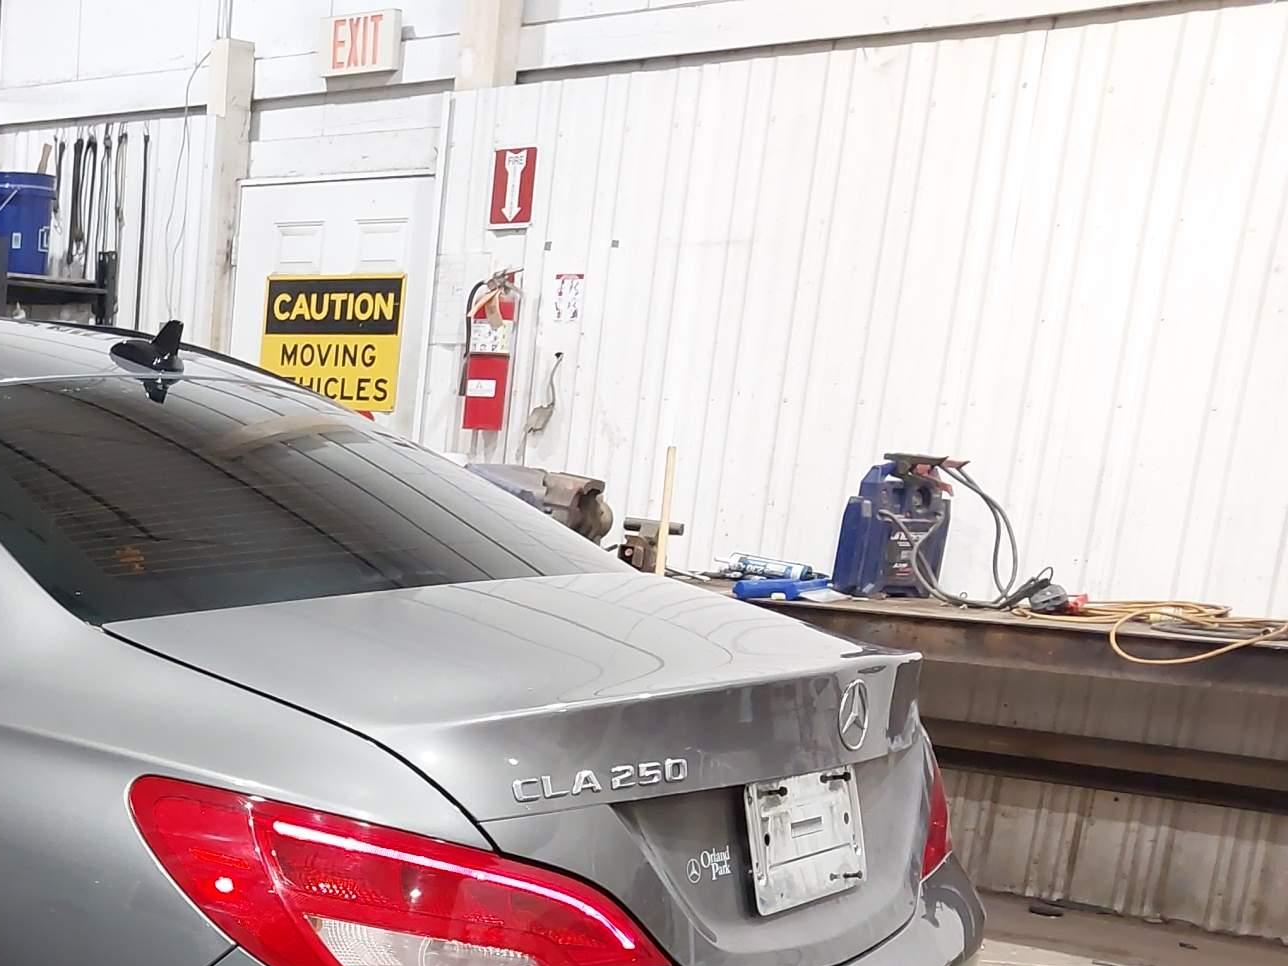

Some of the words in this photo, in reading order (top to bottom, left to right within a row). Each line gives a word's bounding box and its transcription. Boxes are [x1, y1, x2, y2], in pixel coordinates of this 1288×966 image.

[331, 14, 383, 69] EXIT
[273, 292, 395, 321] CAUTION
[280, 343, 377, 368] MOVING
[280, 376, 388, 402] HICLES
[511, 769, 602, 802] CLA
[610, 757, 688, 790] 250
[700, 845, 731, 869] Orland
[711, 860, 732, 881] Park
